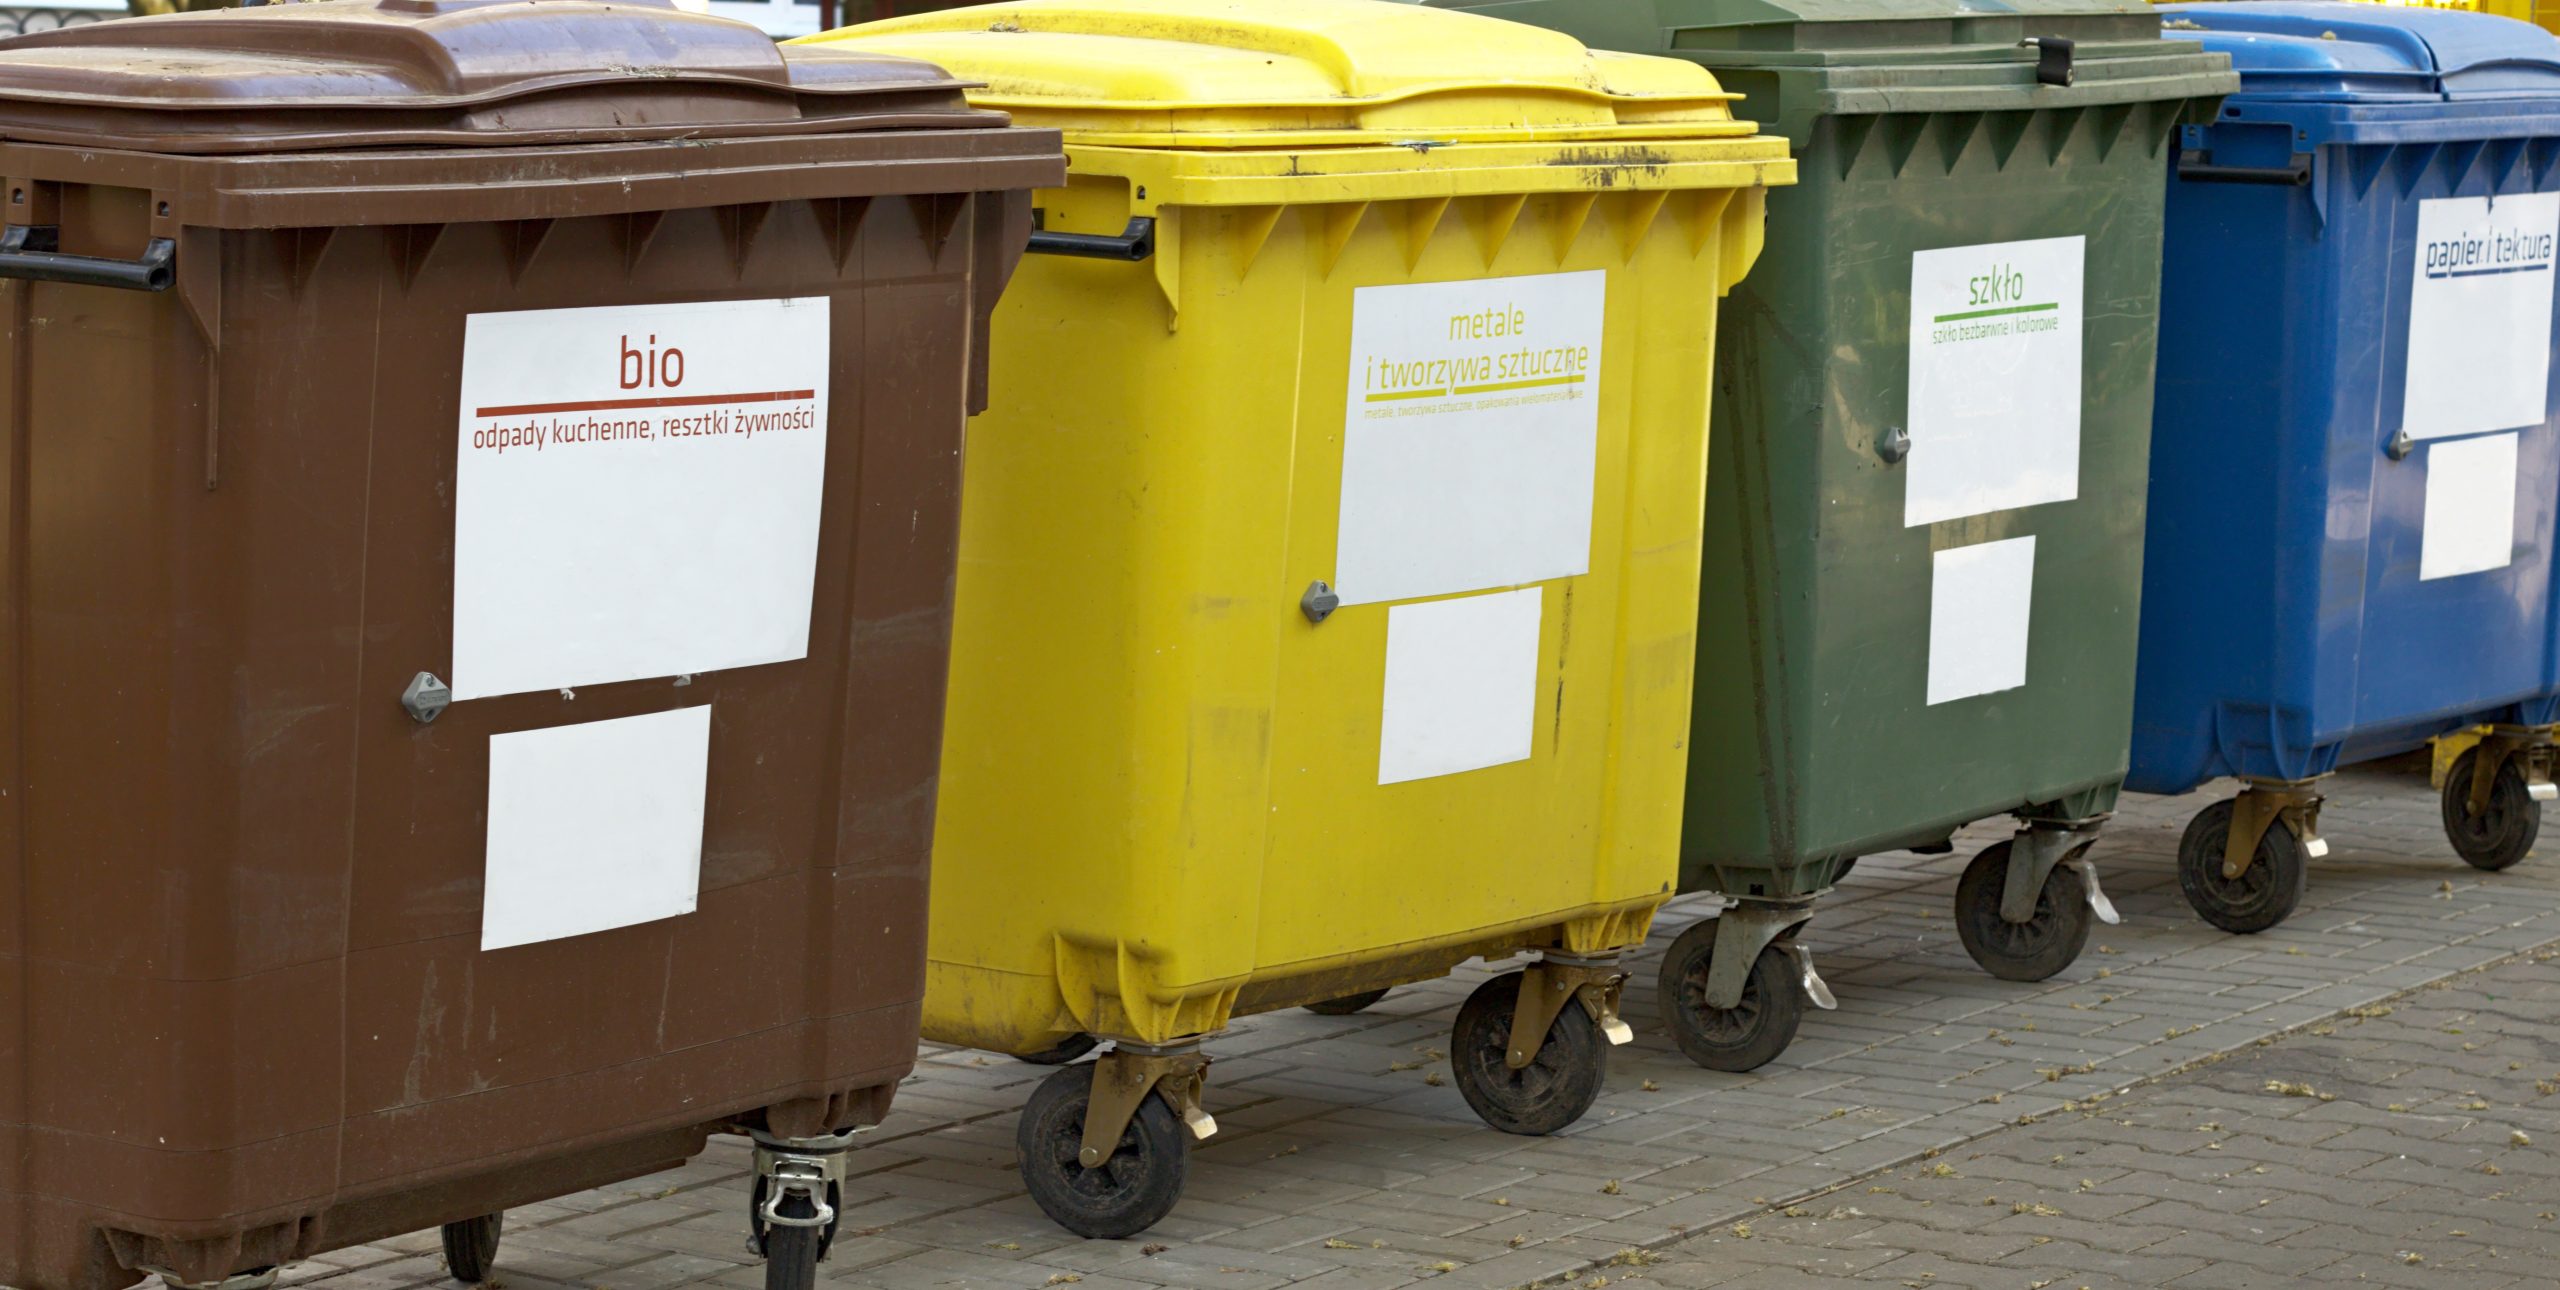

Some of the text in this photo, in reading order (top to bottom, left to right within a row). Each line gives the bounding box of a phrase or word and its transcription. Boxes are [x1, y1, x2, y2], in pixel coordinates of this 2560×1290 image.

[2426, 225, 2552, 278] papier i tektura
[1969, 262, 2023, 306] szkło
[1449, 302, 1525, 341] metale
[1933, 325, 1957, 345] szkło
[1959, 320, 2009, 341] bezbarwne
[2016, 315, 2059, 334] kolorowe
[619, 334, 685, 390] bio
[1366, 345, 1589, 393] i tworzywa sztuczne
[473, 404, 815, 454] odpady kuchenne, resztki żywności
